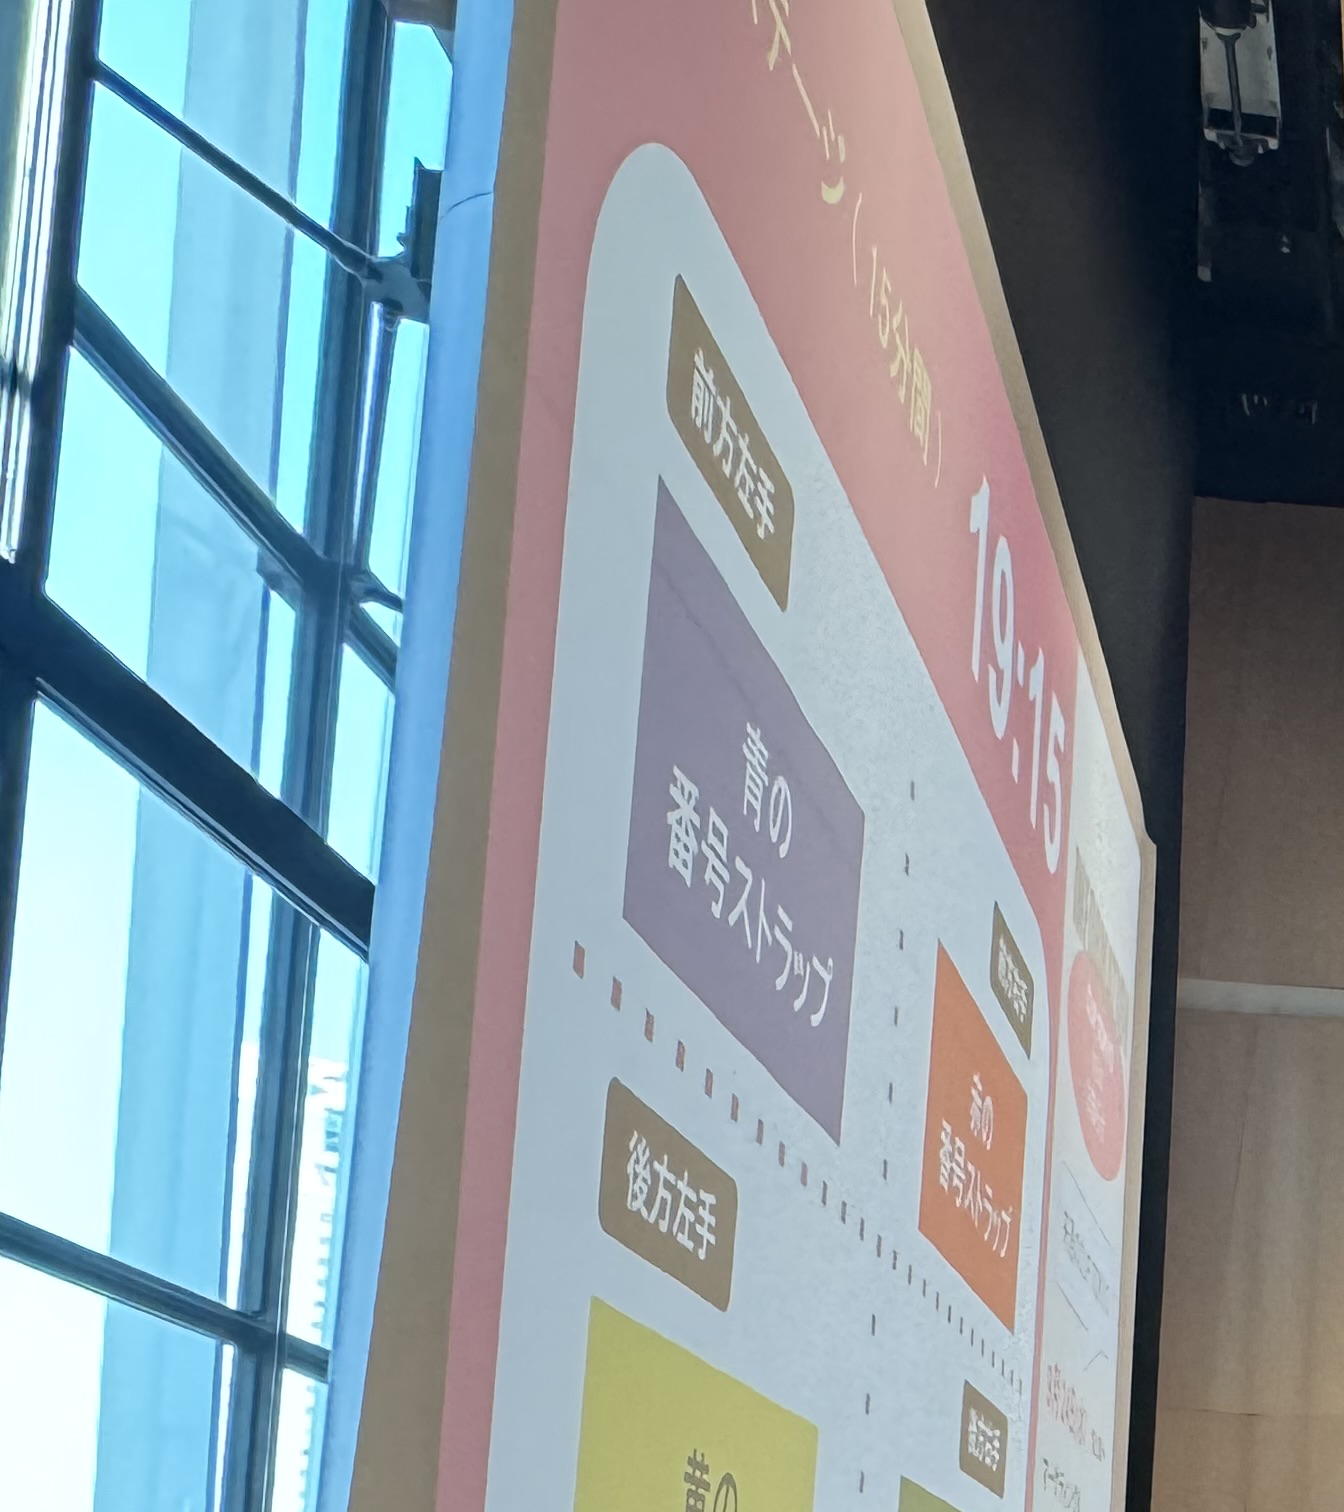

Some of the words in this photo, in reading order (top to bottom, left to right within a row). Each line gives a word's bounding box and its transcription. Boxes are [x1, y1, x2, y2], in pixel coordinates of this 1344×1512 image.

[690, 347, 775, 540] 前方左手
[971, 475, 1066, 876] 19:15
[742, 721, 792, 858] 青の
[666, 764, 833, 1028] 番号ストラップ
[627, 1130, 717, 1260] 後方左手
[939, 1117, 1014, 1258] 番号ストラップ
